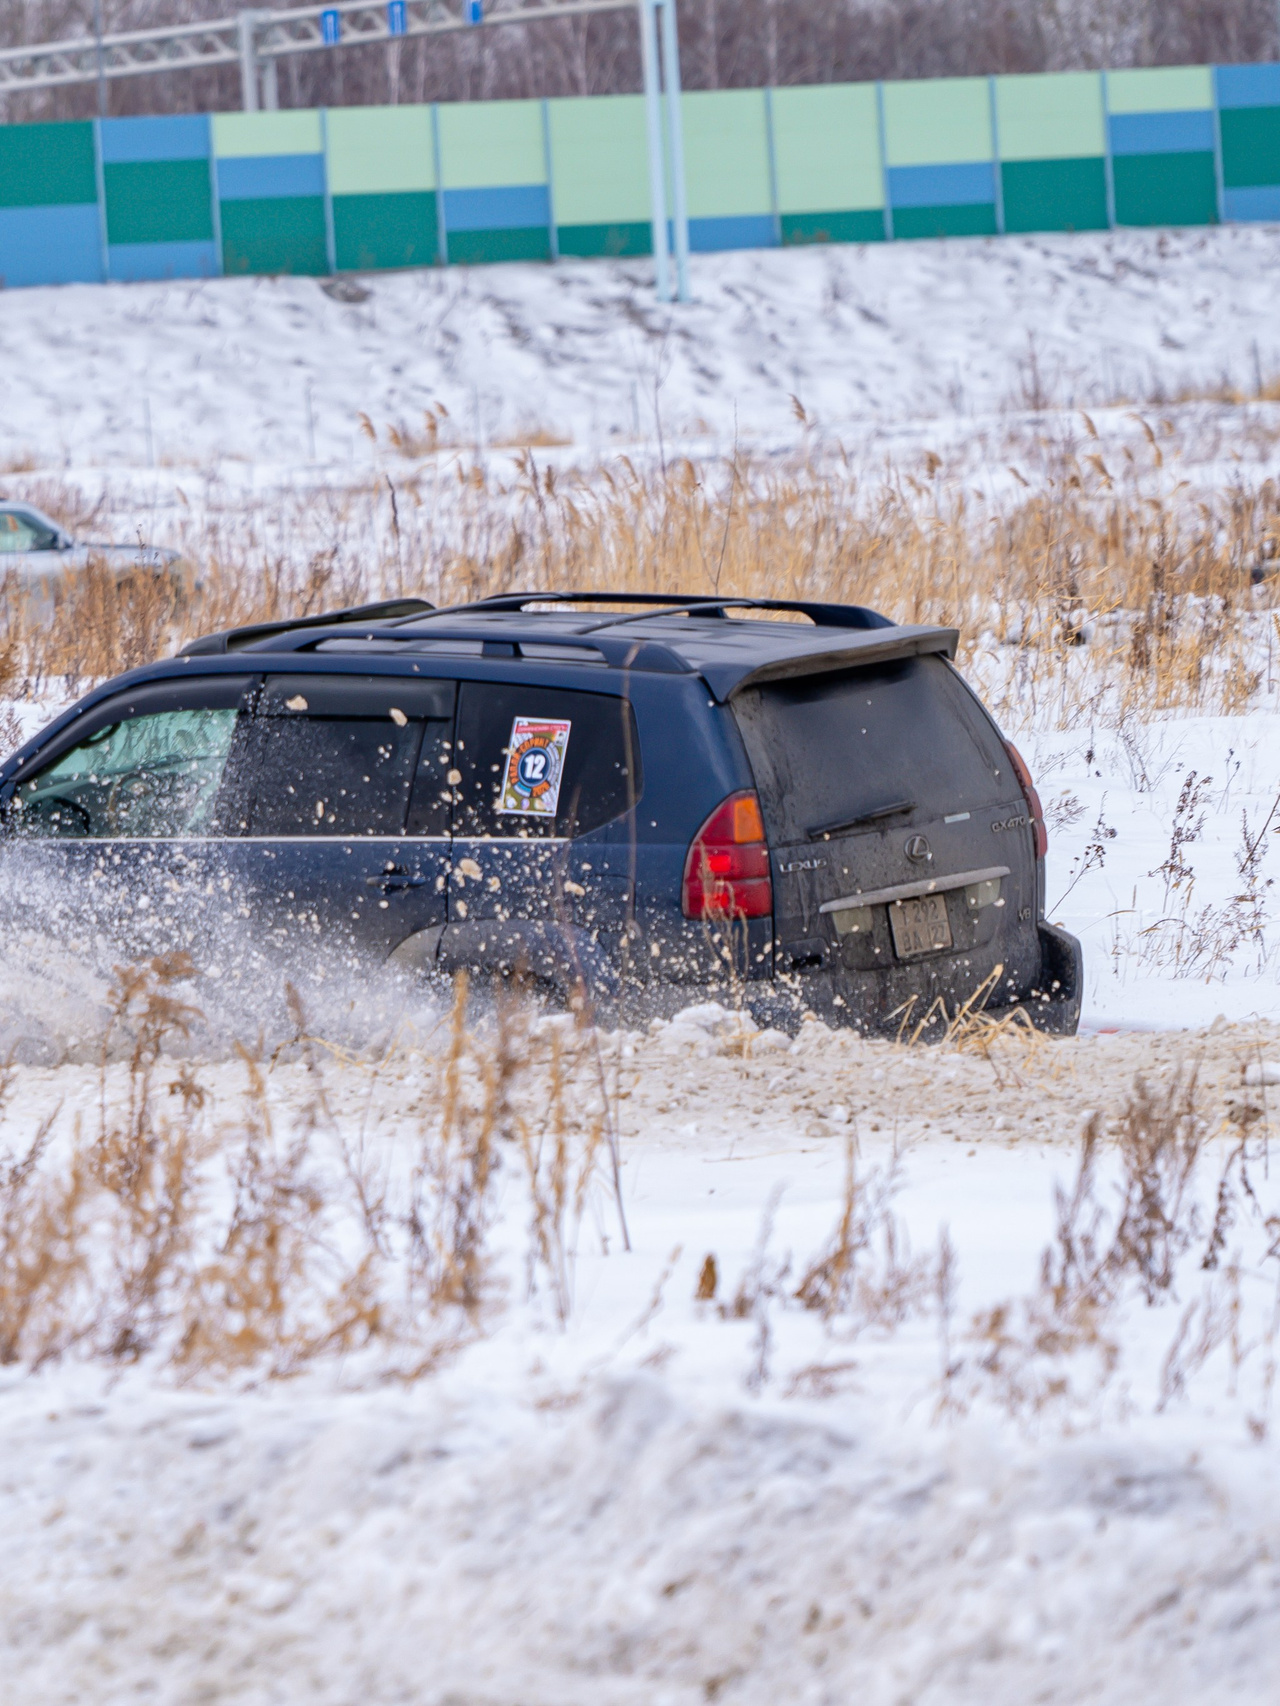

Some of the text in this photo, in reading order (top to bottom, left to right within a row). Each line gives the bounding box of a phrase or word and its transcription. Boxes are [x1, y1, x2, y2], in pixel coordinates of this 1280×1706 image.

[524, 754, 546, 779] 12
[779, 857, 827, 873] LEXUS
[1018, 907, 1032, 921] V8
